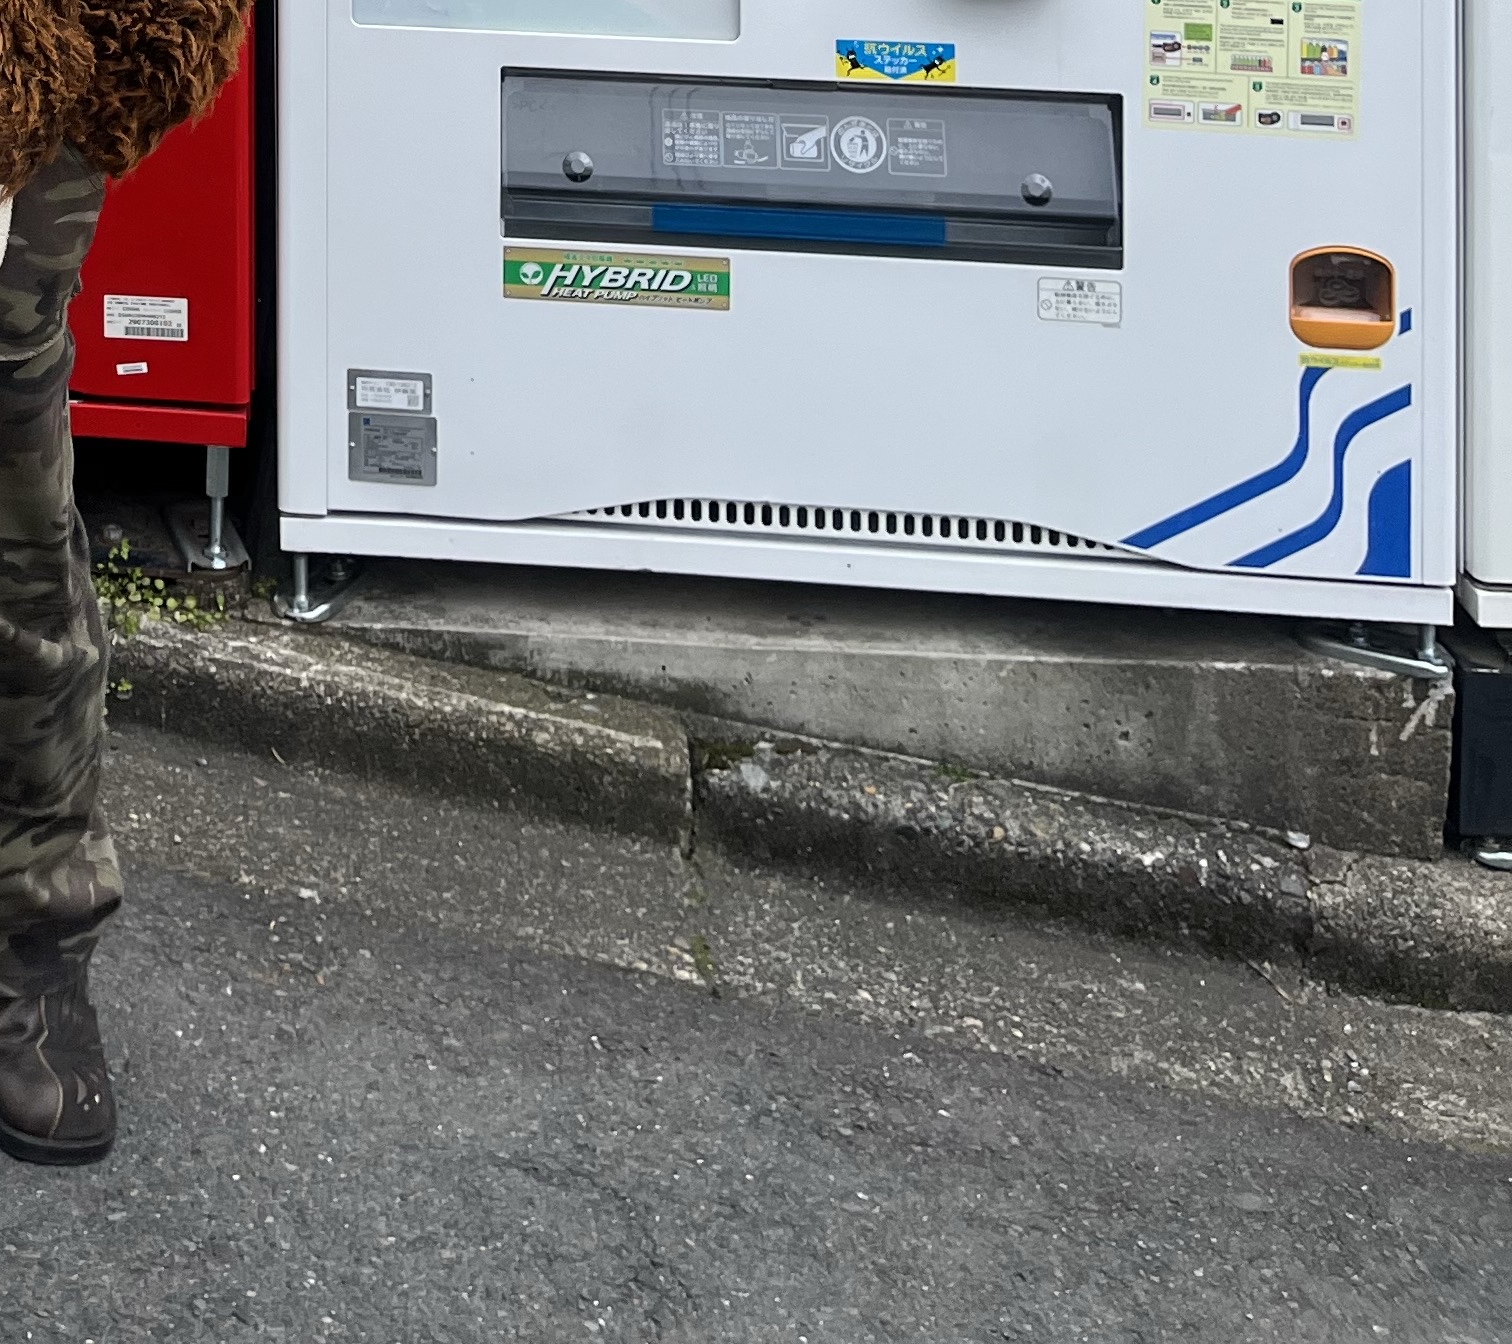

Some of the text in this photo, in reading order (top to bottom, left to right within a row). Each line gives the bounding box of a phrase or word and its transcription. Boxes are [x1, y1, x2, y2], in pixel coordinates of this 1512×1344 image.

[874, 55, 917, 65] ステッカー
[540, 263, 693, 297] HYBRID
[697, 273, 718, 283] LED
[552, 287, 639, 301] HEAT PUMP
